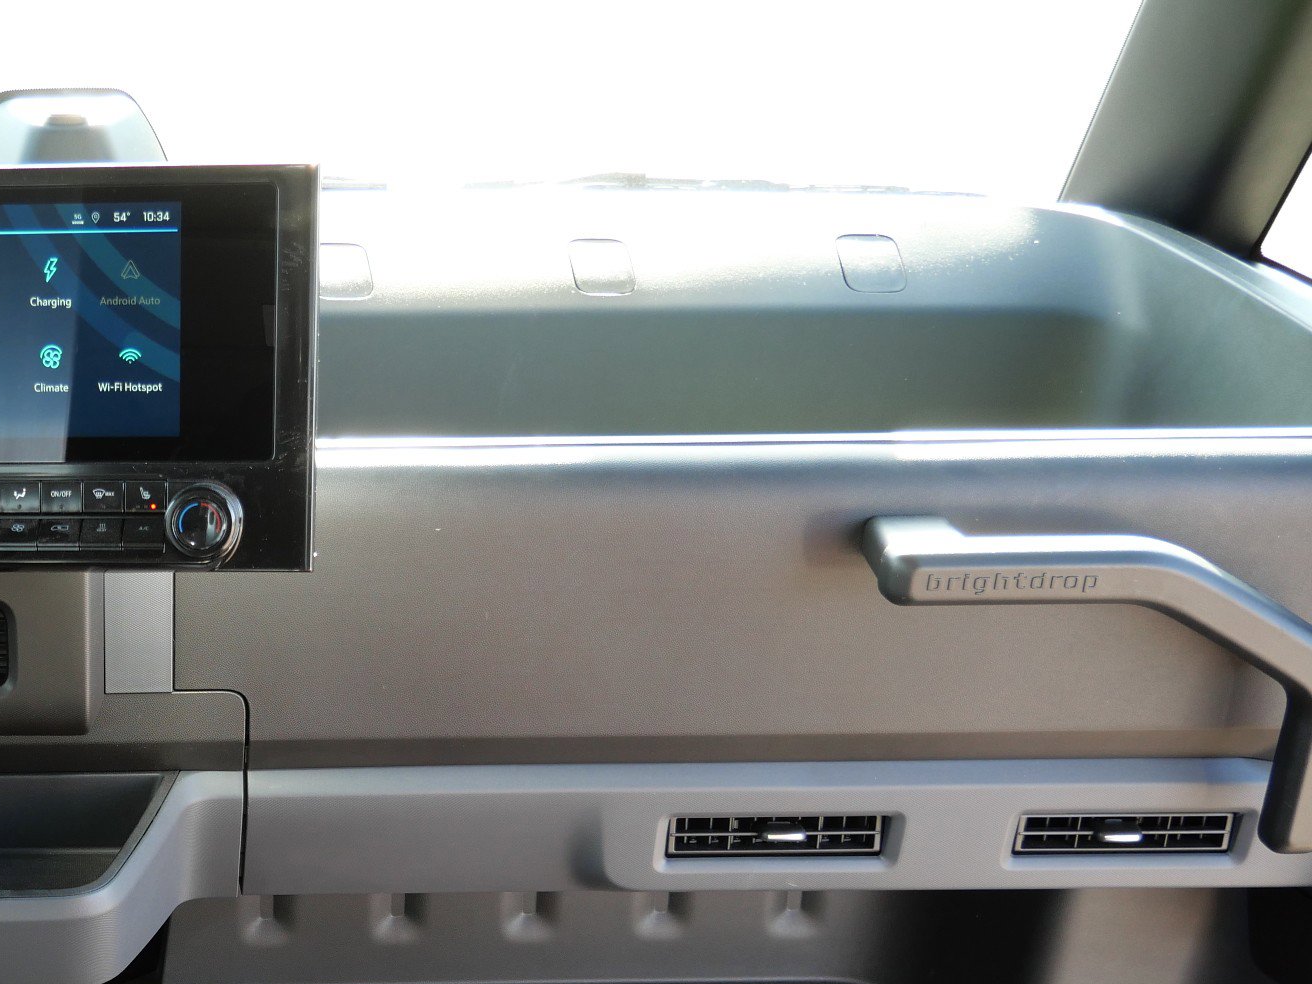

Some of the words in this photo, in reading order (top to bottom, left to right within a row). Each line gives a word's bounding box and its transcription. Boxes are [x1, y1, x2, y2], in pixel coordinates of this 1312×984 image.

[113, 211, 131, 222] 54°
[143, 211, 170, 222] 10:34
[30, 297, 72, 309] Charging
[100, 296, 137, 306] Android
[139, 296, 160, 306] Auto
[34, 383, 69, 393] Climate
[98, 382, 123, 392] Wi-Fi
[124, 382, 163, 394] Hotspot
[50, 490, 72, 498] ON/OFF
[926, 572, 1099, 595] brightdrop
